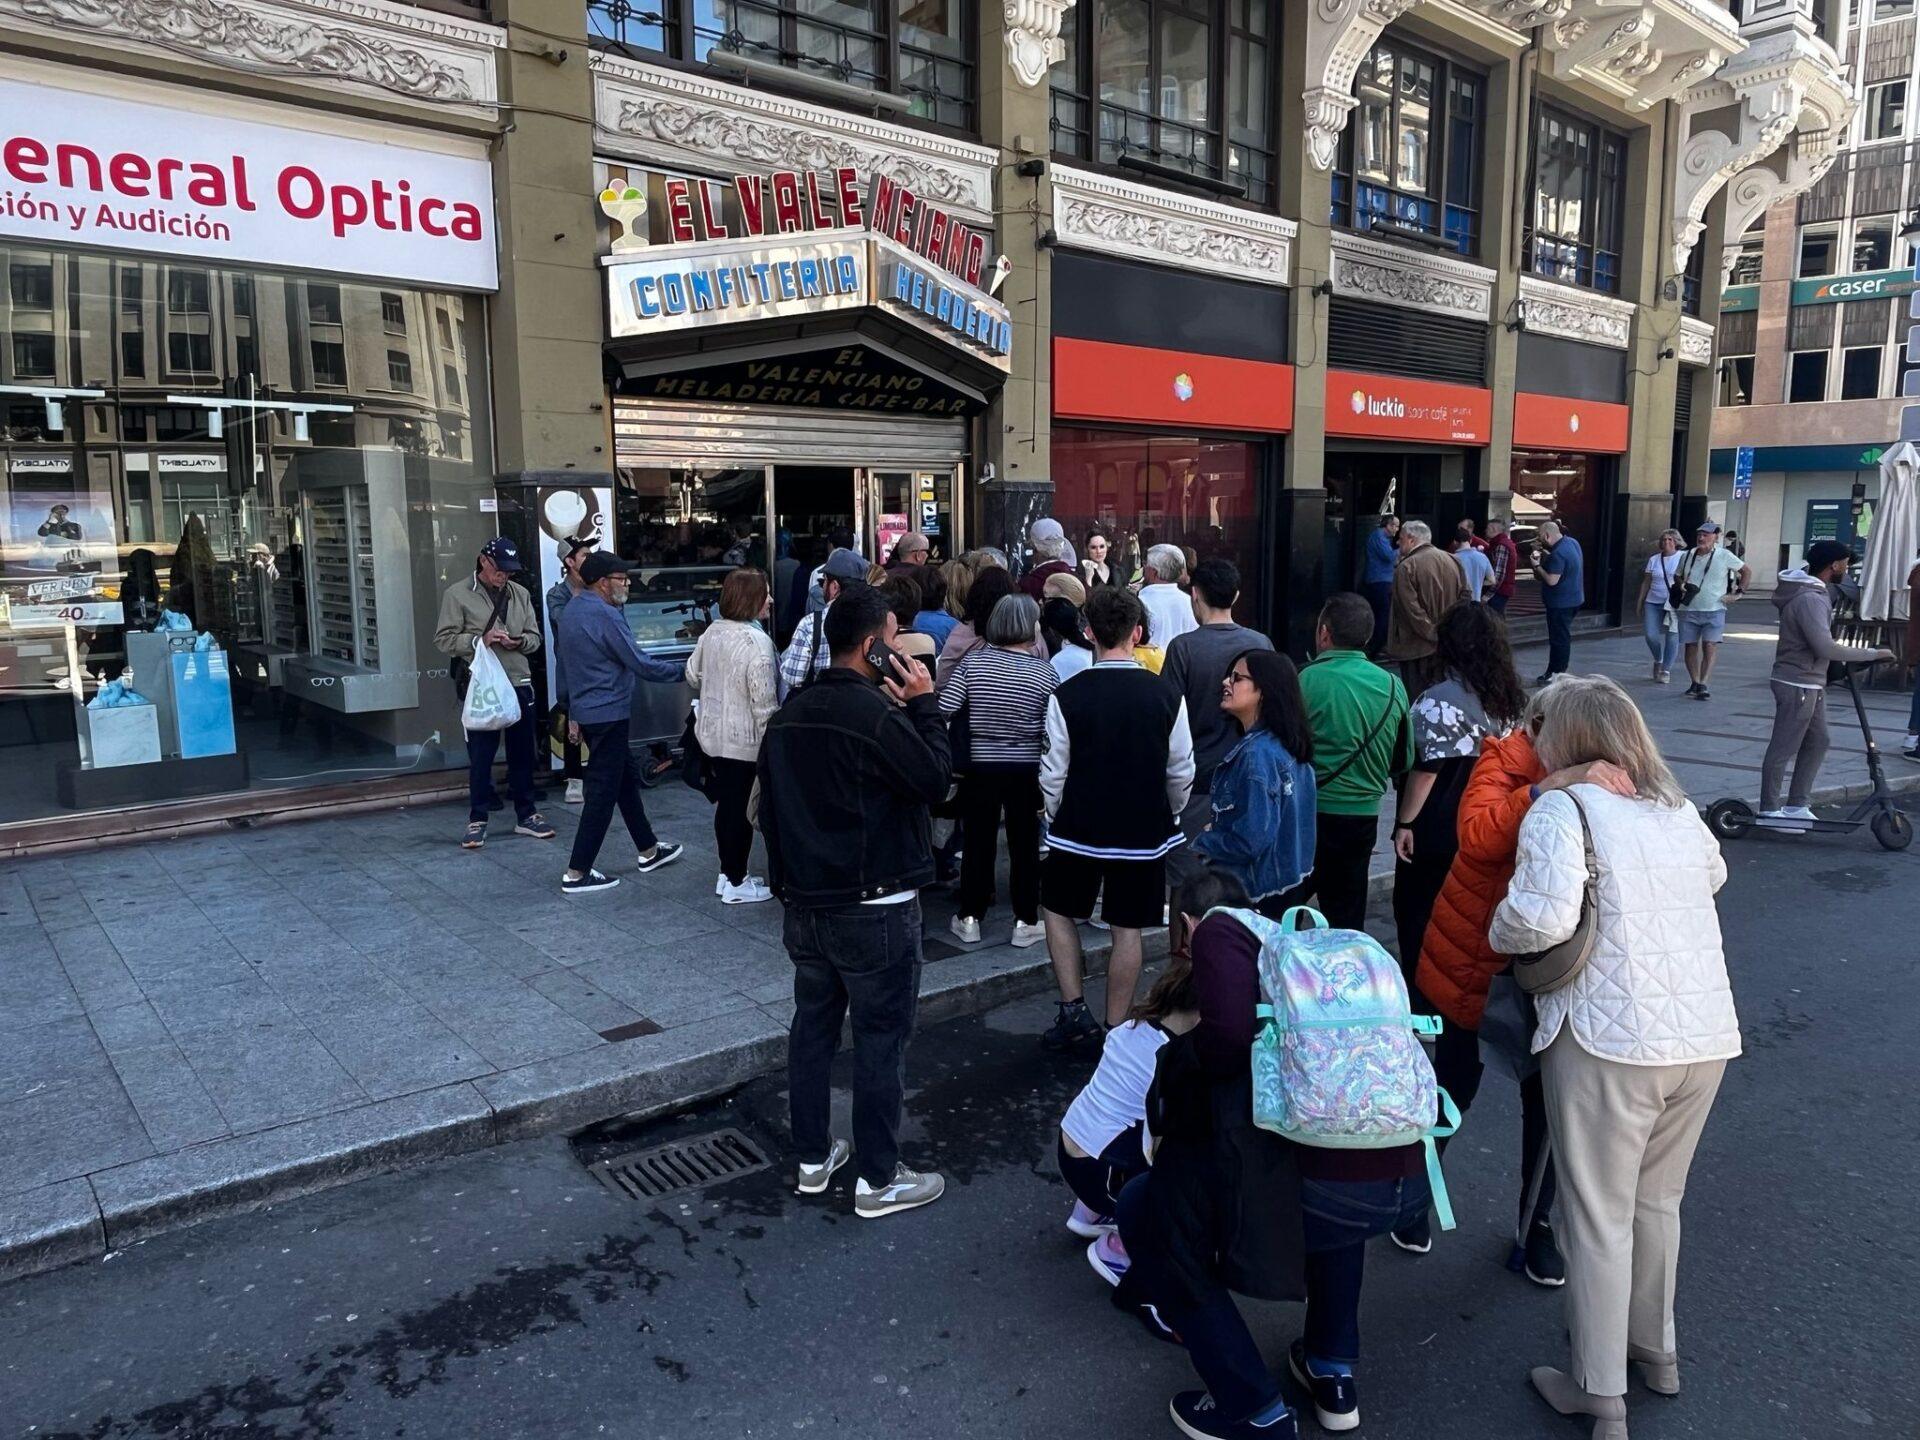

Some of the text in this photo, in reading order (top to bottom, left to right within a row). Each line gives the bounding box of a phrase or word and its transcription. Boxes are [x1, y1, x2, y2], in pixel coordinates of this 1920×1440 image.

[278, 165, 483, 241] Optica
[69, 206, 87, 230] y
[95, 202, 231, 241] Audición
[665, 167, 985, 287] EL VALENCIANO
[632, 255, 860, 318] CONFITERIA
[1829, 278, 1887, 297] caser
[896, 262, 1011, 355] HELADERIA
[834, 350, 864, 366] EL
[654, 377, 967, 413] HELADERIA CAFE-BAR
[747, 363, 925, 391] VALENCIANO
[1368, 394, 1405, 418] luckia
[58, 606, 84, 621] 40
